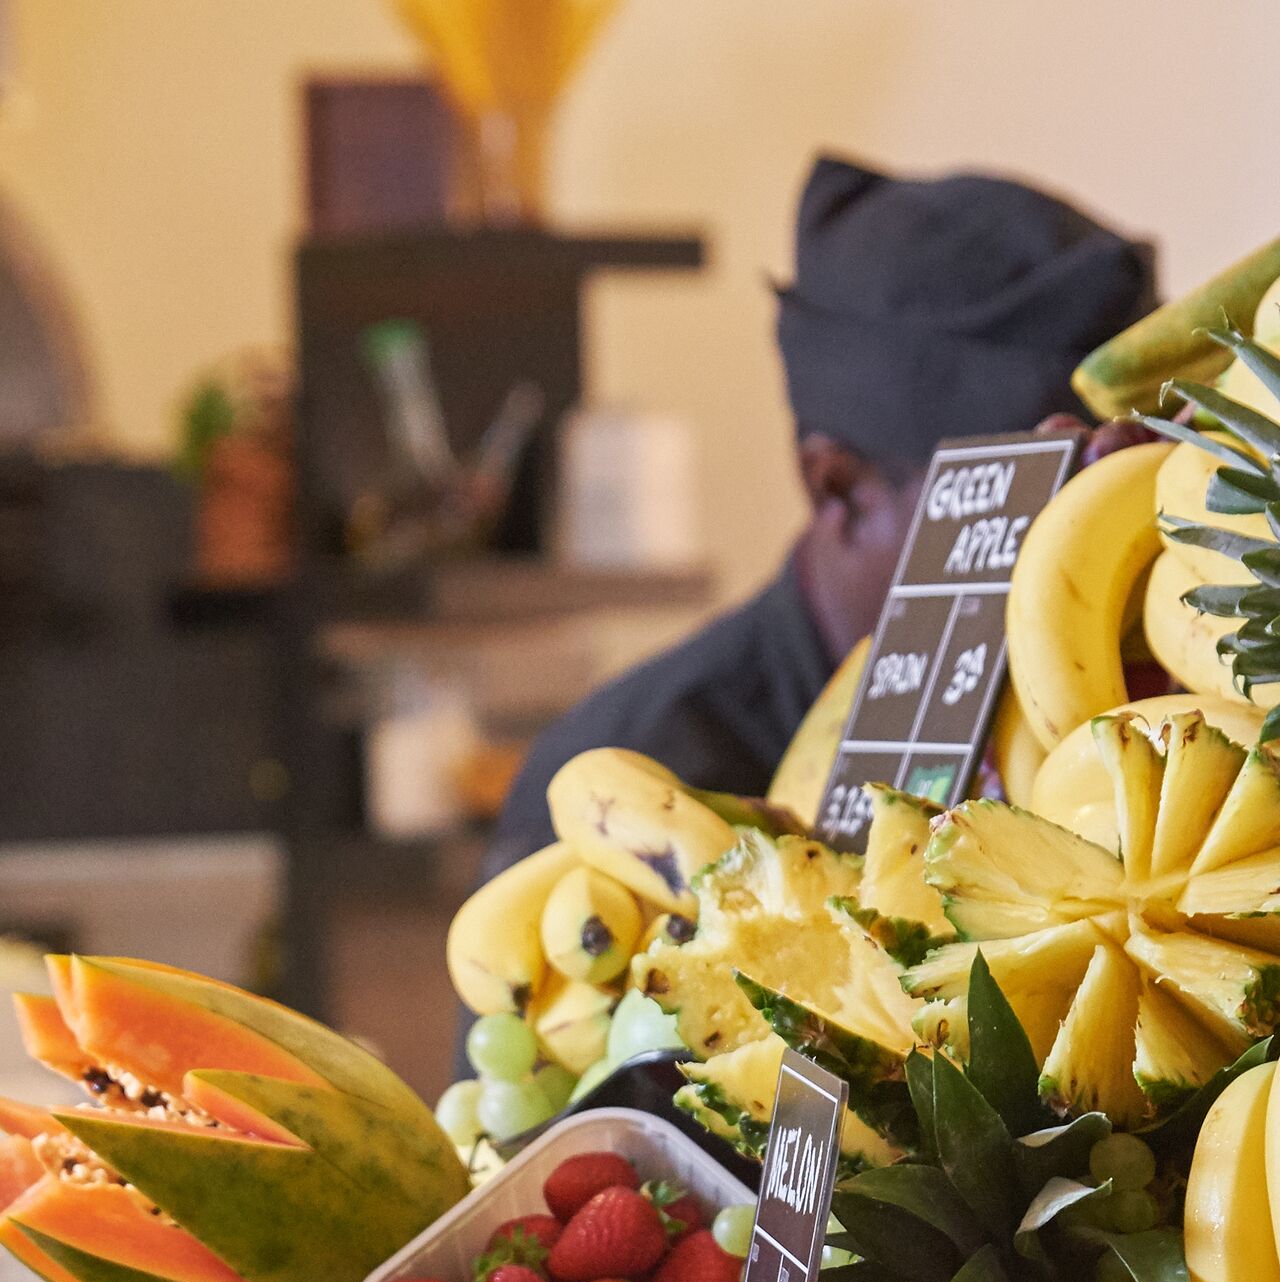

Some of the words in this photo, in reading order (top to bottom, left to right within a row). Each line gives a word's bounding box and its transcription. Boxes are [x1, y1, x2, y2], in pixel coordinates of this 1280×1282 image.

[927, 462, 1015, 520] GREEN
[944, 516, 1028, 573] APPLE
[766, 1124, 824, 1215] MELON
